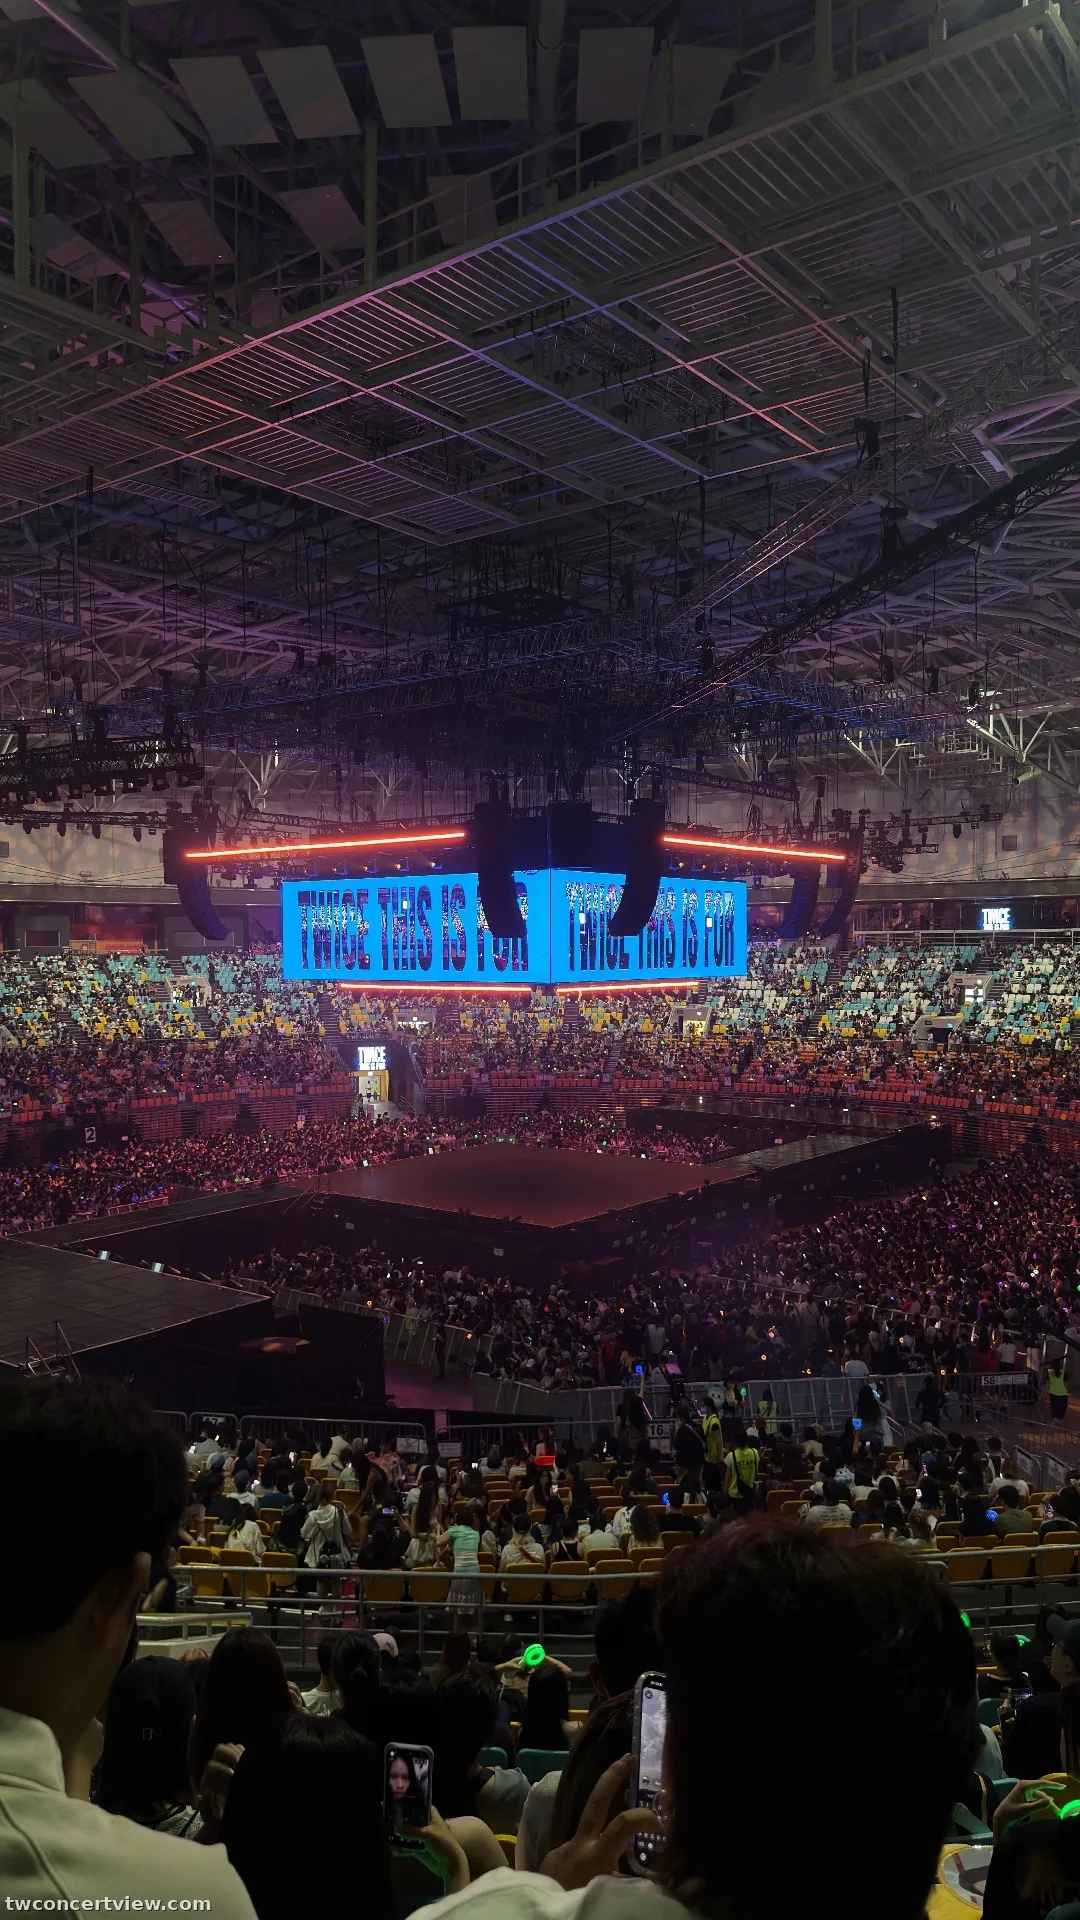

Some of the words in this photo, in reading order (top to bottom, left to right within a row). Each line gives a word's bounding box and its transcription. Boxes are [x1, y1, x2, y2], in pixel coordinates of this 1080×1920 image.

[298, 888, 370, 970] TWICE
[377, 886, 432, 971] THIS
[442, 884, 466, 971] IS
[682, 888, 698, 968] IS
[704, 889, 734, 967] FOR
[358, 1046, 386, 1063] TWICE
[86, 1128, 95, 1141] 2
[983, 1376, 996, 1386] S6
[649, 1425, 664, 1436] 16
